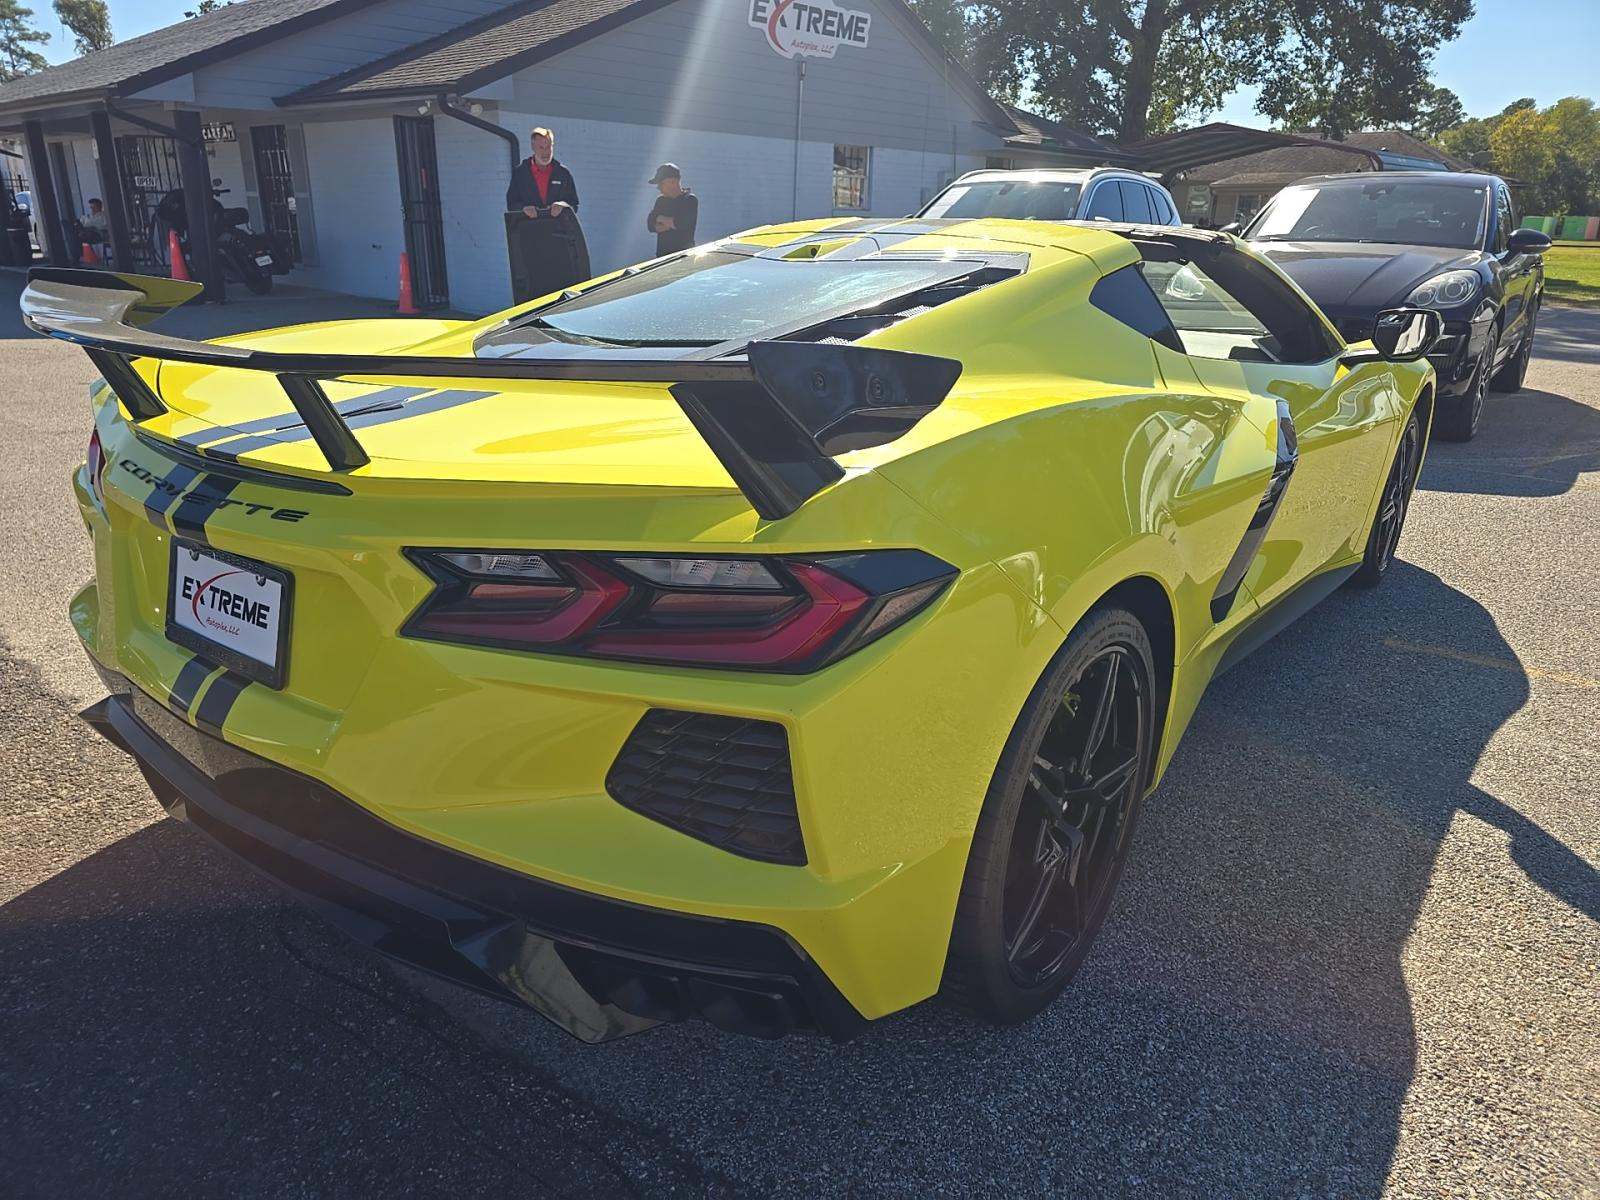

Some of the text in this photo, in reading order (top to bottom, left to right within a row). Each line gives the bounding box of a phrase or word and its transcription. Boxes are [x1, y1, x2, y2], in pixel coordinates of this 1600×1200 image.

[752, 0, 868, 43] EXTREME
[119, 459, 310, 523] CORVETTE
[182, 576, 270, 630] EXTREME
